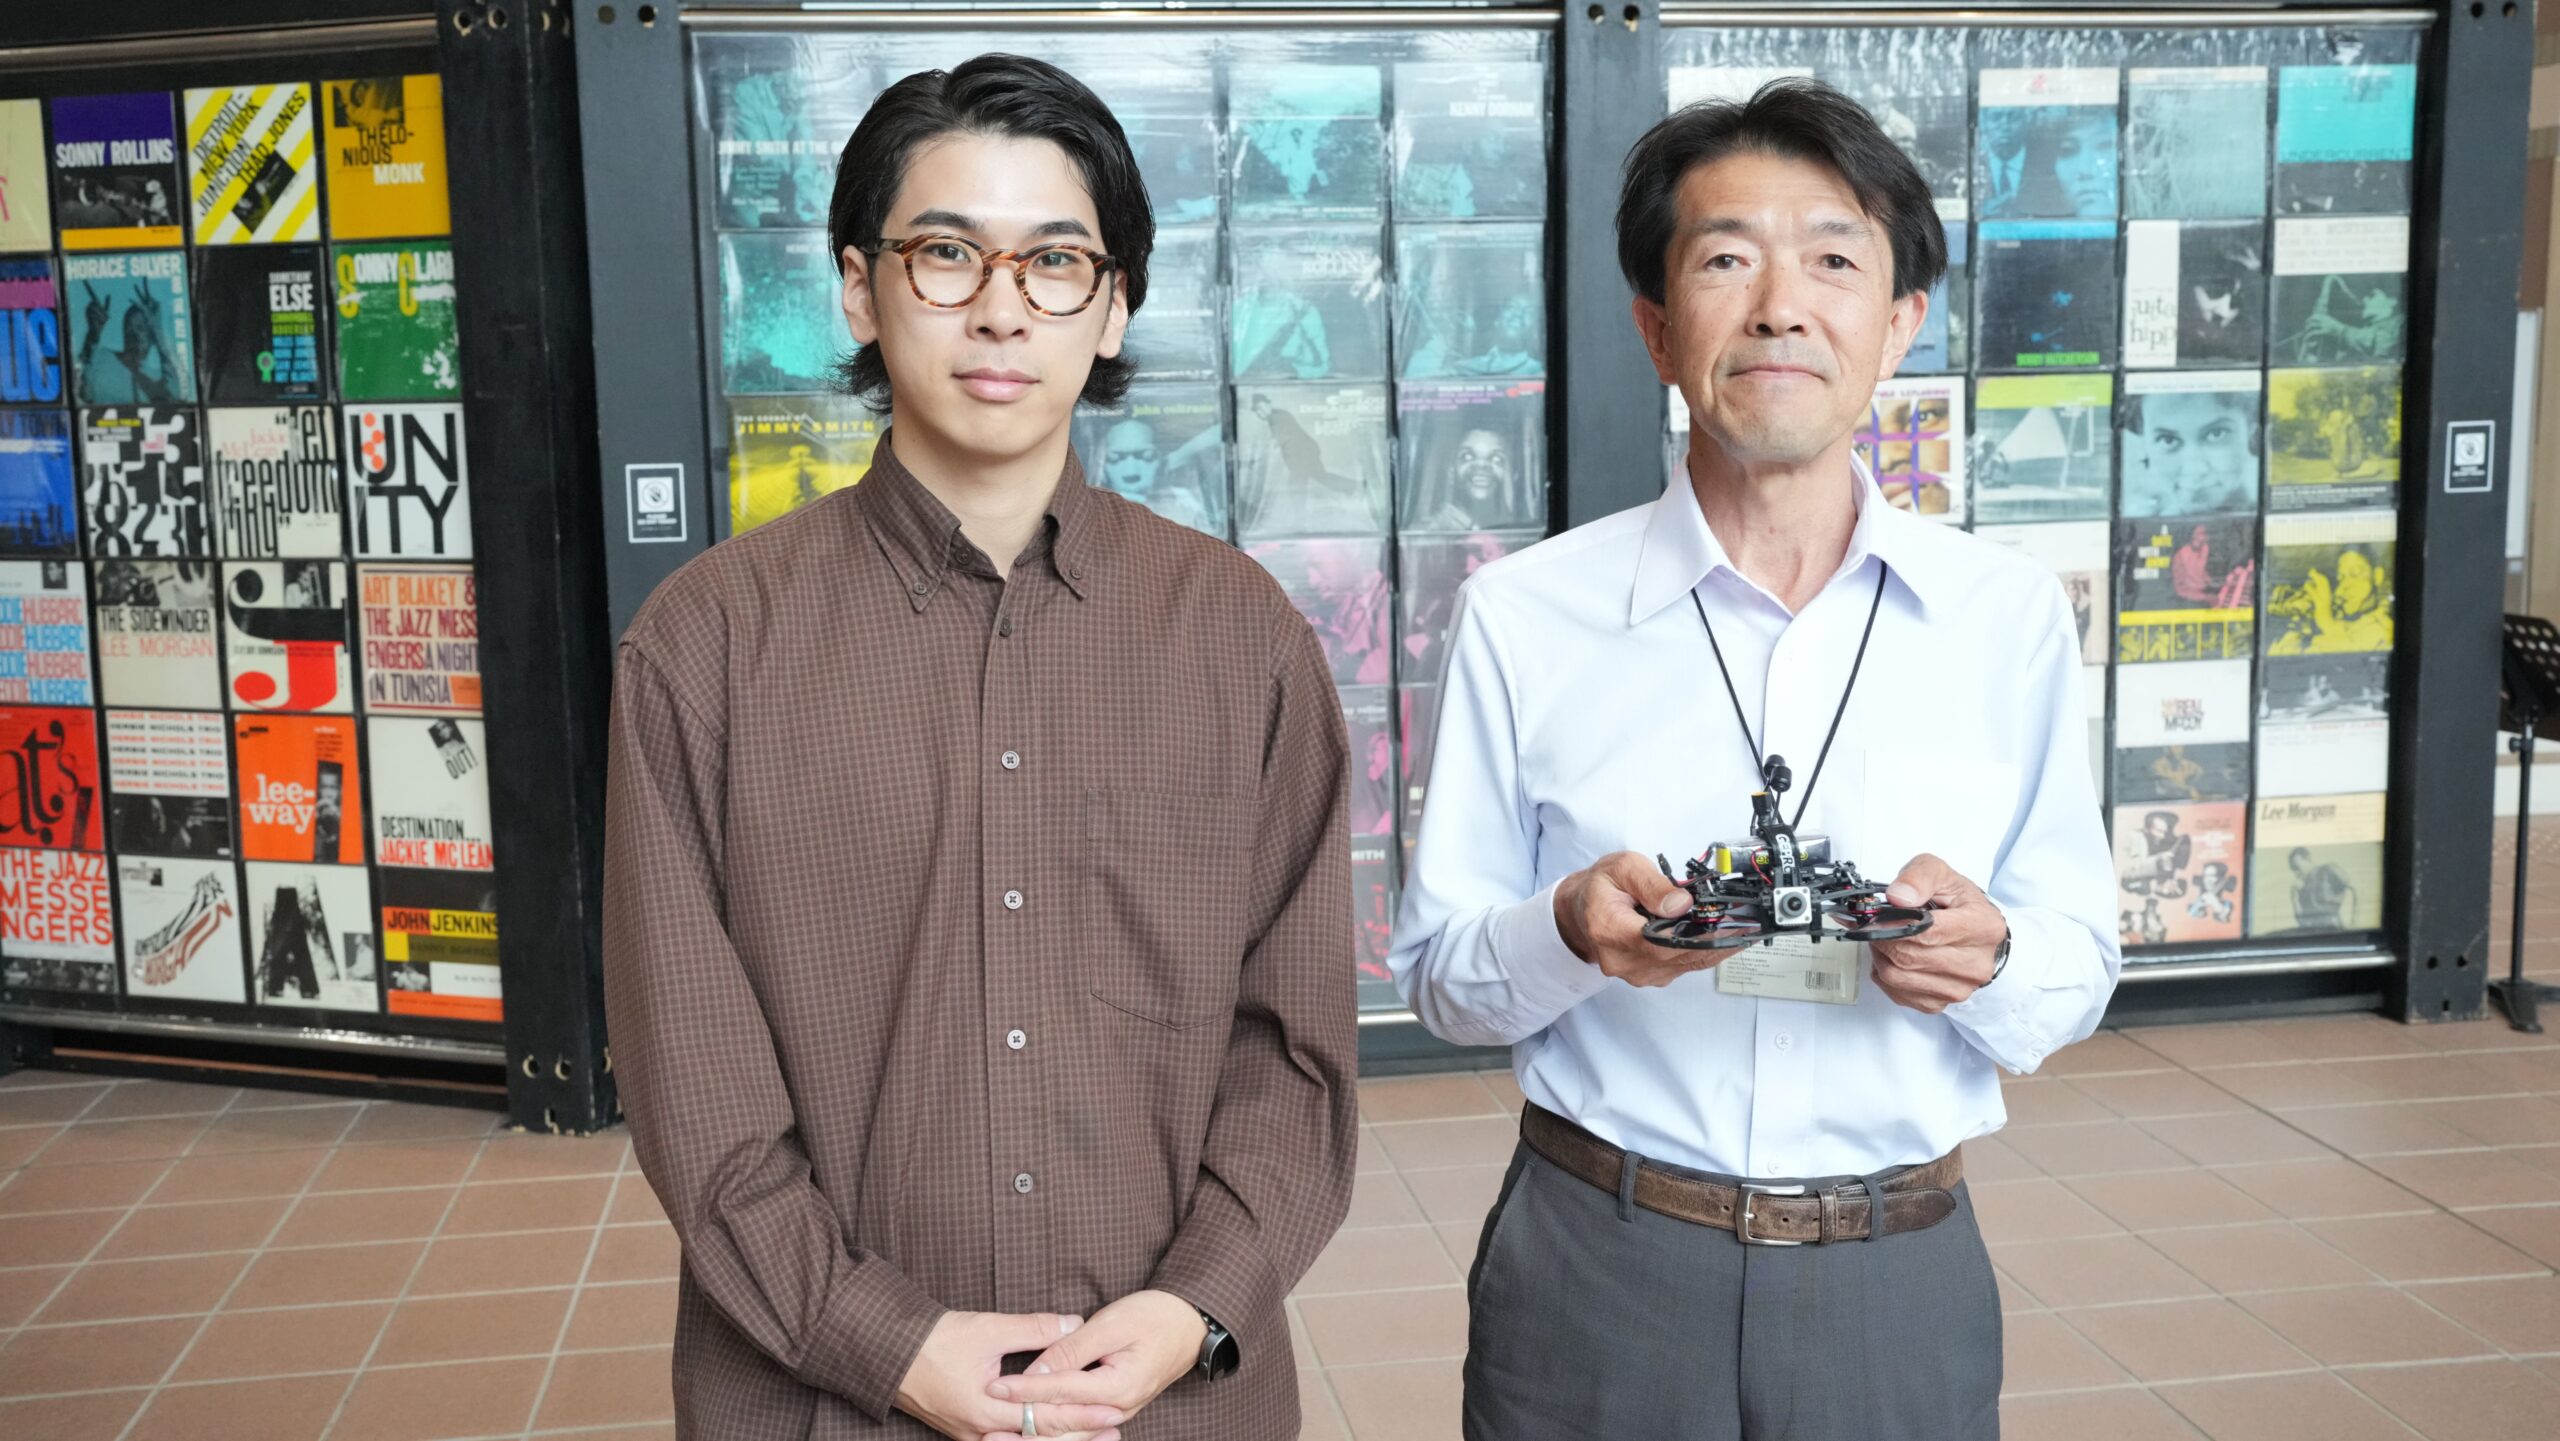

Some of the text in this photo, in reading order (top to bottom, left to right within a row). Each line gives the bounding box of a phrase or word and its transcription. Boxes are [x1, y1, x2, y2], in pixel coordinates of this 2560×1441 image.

[55, 138, 174, 168] SONNY ROLLINS
[200, 98, 263, 182] NEW YORK
[237, 91, 308, 186] THAD JONES
[343, 147, 393, 167] NIOUS
[197, 138, 253, 217] JUNCTION
[373, 163, 425, 185] MONK
[67, 255, 182, 280] HORACE SILVER
[270, 284, 315, 312] ELSE
[337, 253, 399, 318] SONNY
[739, 421, 875, 434] JIMMY SMITH
[351, 412, 459, 484] UN
[354, 485, 458, 554] ITY
[363, 576, 391, 605] ART
[398, 576, 457, 606] BLAKEY
[101, 608, 212, 633] THE SIDEWINDER
[364, 608, 478, 639] THE JAZZ MESS
[101, 635, 214, 657] LEE MORGAN
[366, 641, 425, 669] ENGERS
[424, 643, 435, 669] A
[369, 672, 452, 704] IN TUNISIA
[444, 748, 480, 780] OUT!
[256, 774, 317, 803] lee-
[249, 802, 315, 834] way
[2261, 803, 2285, 820] Lee
[0, 852, 44, 880] THE
[50, 854, 106, 883] JAZZ
[379, 839, 428, 867] JACKIE
[0, 880, 111, 914] MESSE
[1, 907, 113, 946] NGERS
[387, 911, 498, 936] JOHN JENKINS
